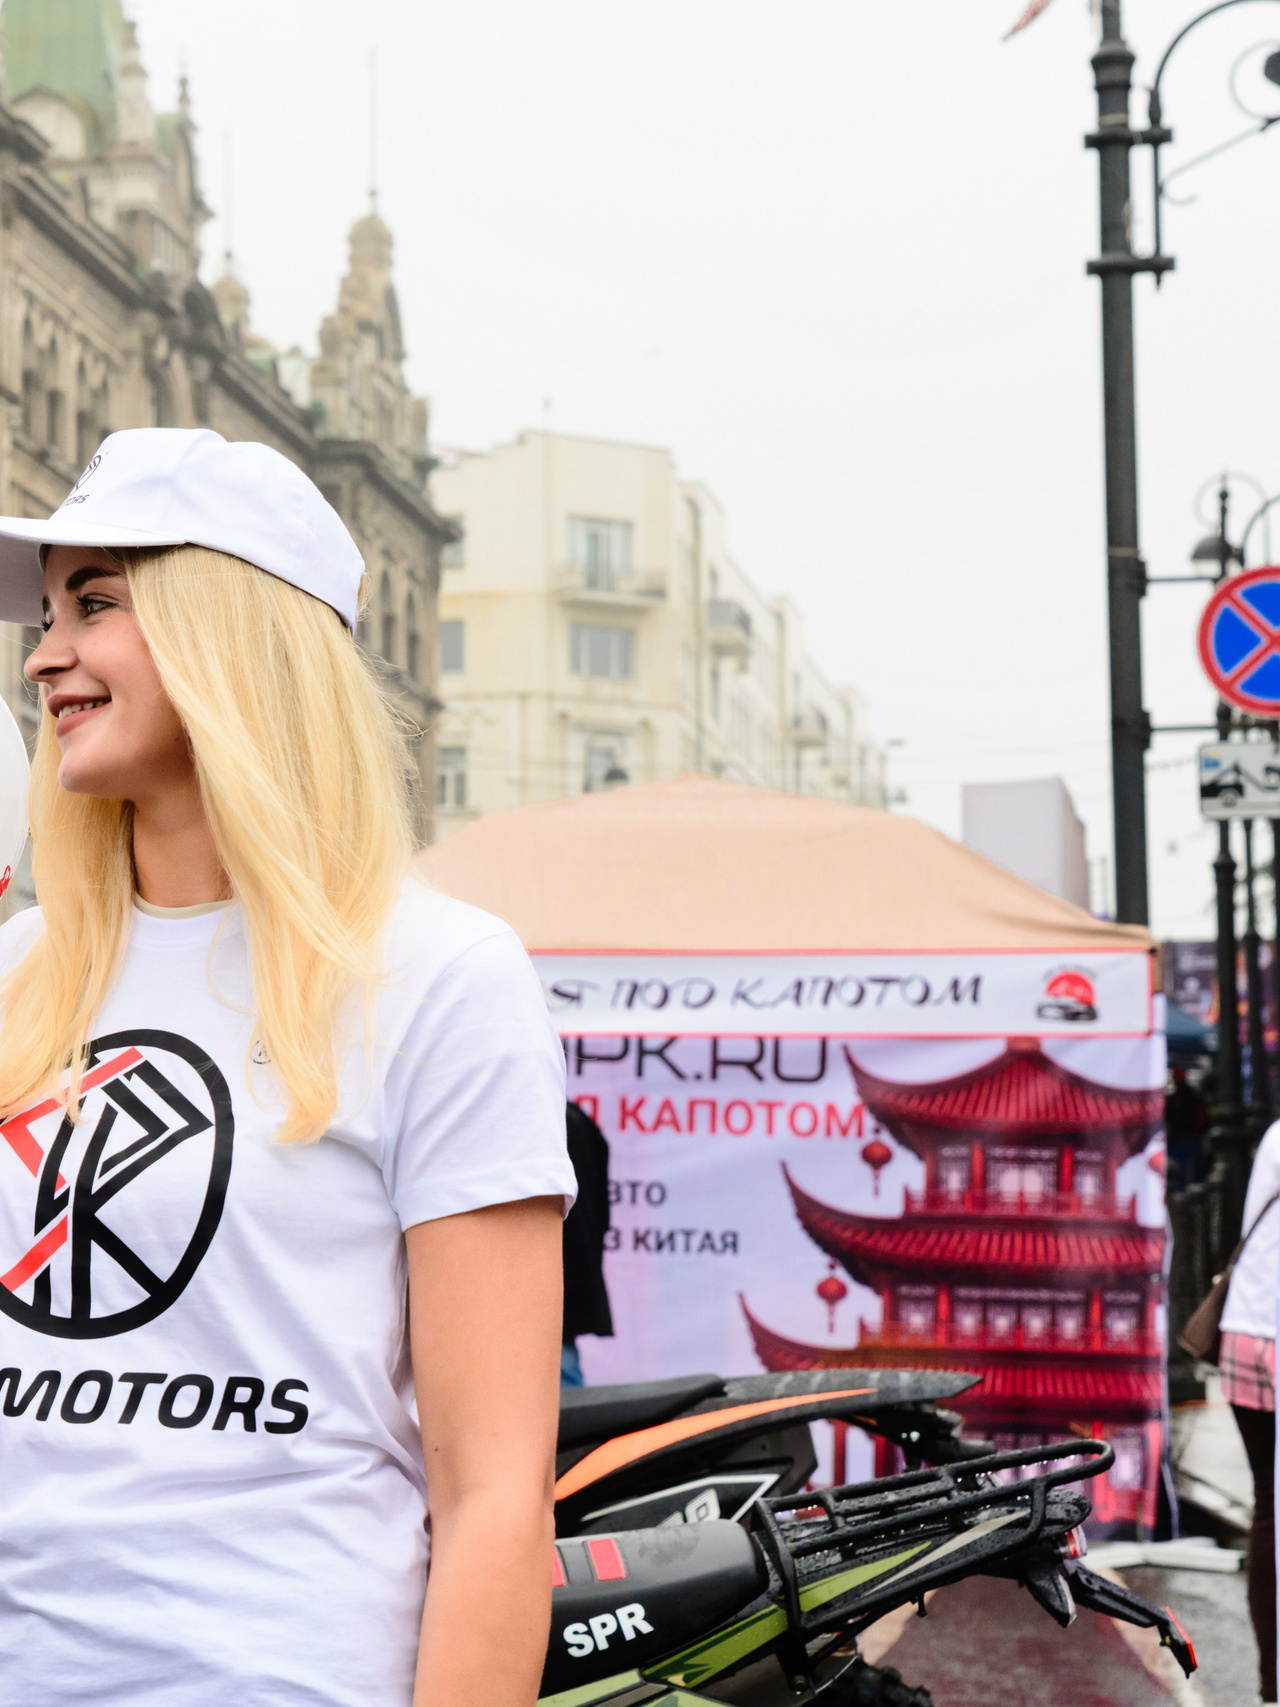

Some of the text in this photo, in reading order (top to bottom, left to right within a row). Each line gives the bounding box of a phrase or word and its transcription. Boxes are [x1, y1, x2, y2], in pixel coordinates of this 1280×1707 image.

[609, 976, 716, 1010] ПОД
[730, 974, 983, 1010] КАПОТОМ
[563, 1036, 827, 1082] PK.RU
[618, 1094, 865, 1139] КАПОТОМ
[633, 1227, 739, 1255] КИТАЯ
[562, 1602, 655, 1658] SPR
